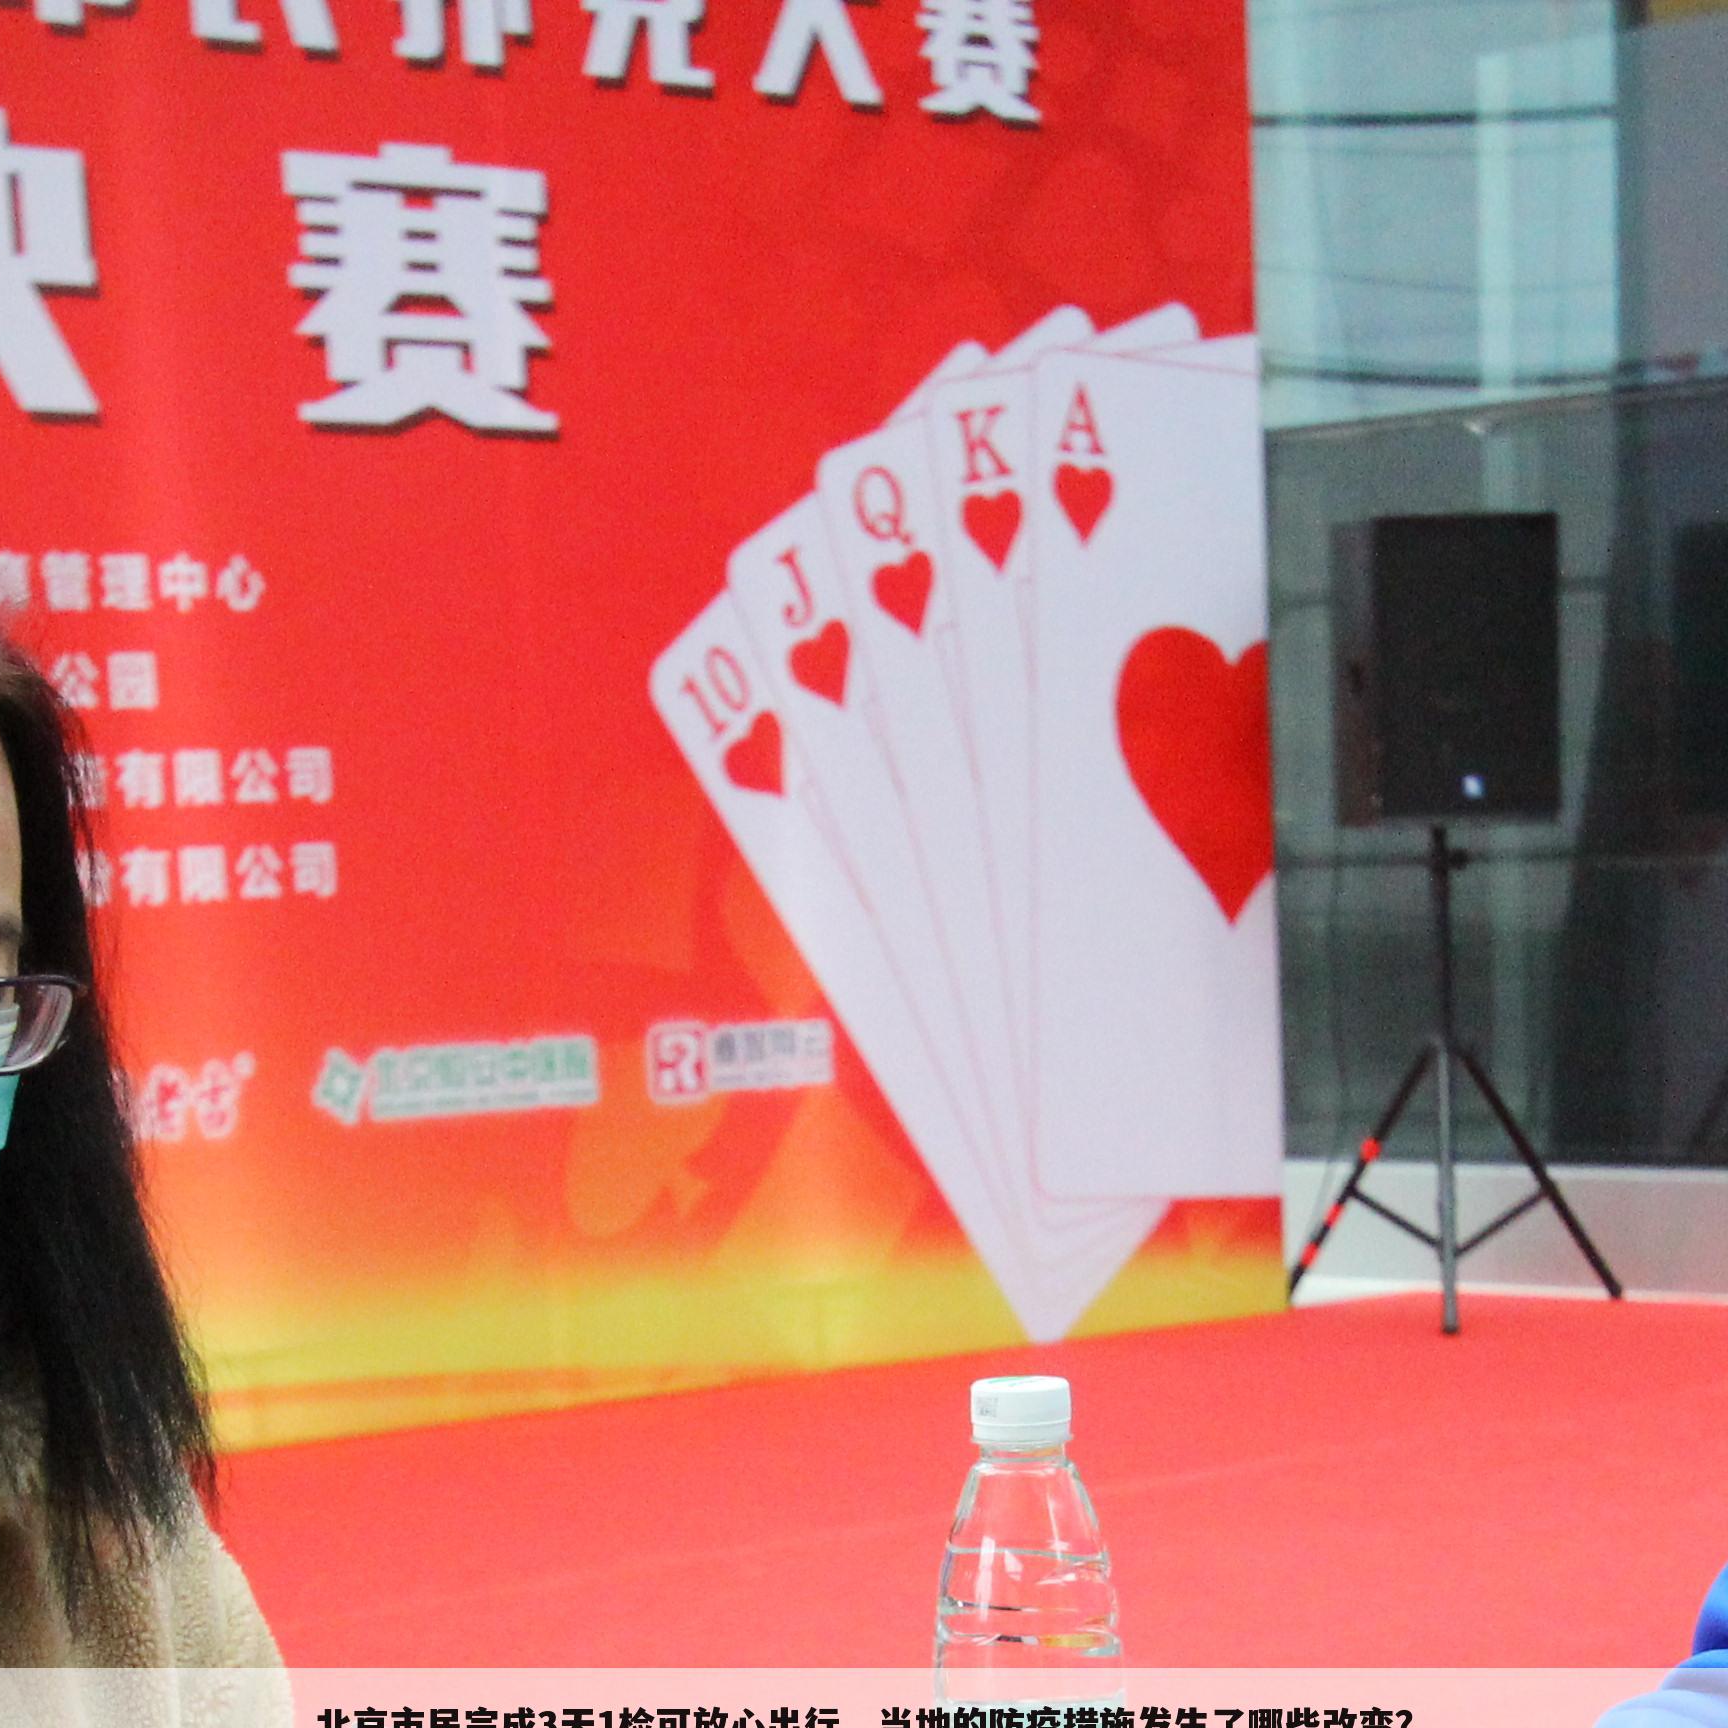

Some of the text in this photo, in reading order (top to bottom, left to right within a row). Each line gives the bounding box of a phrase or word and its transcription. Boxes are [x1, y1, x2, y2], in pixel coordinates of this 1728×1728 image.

[954, 404, 1012, 484] K
[1057, 381, 1105, 456] A
[852, 466, 914, 546] Q
[776, 545, 816, 628] J
[680, 646, 750, 738] 10
